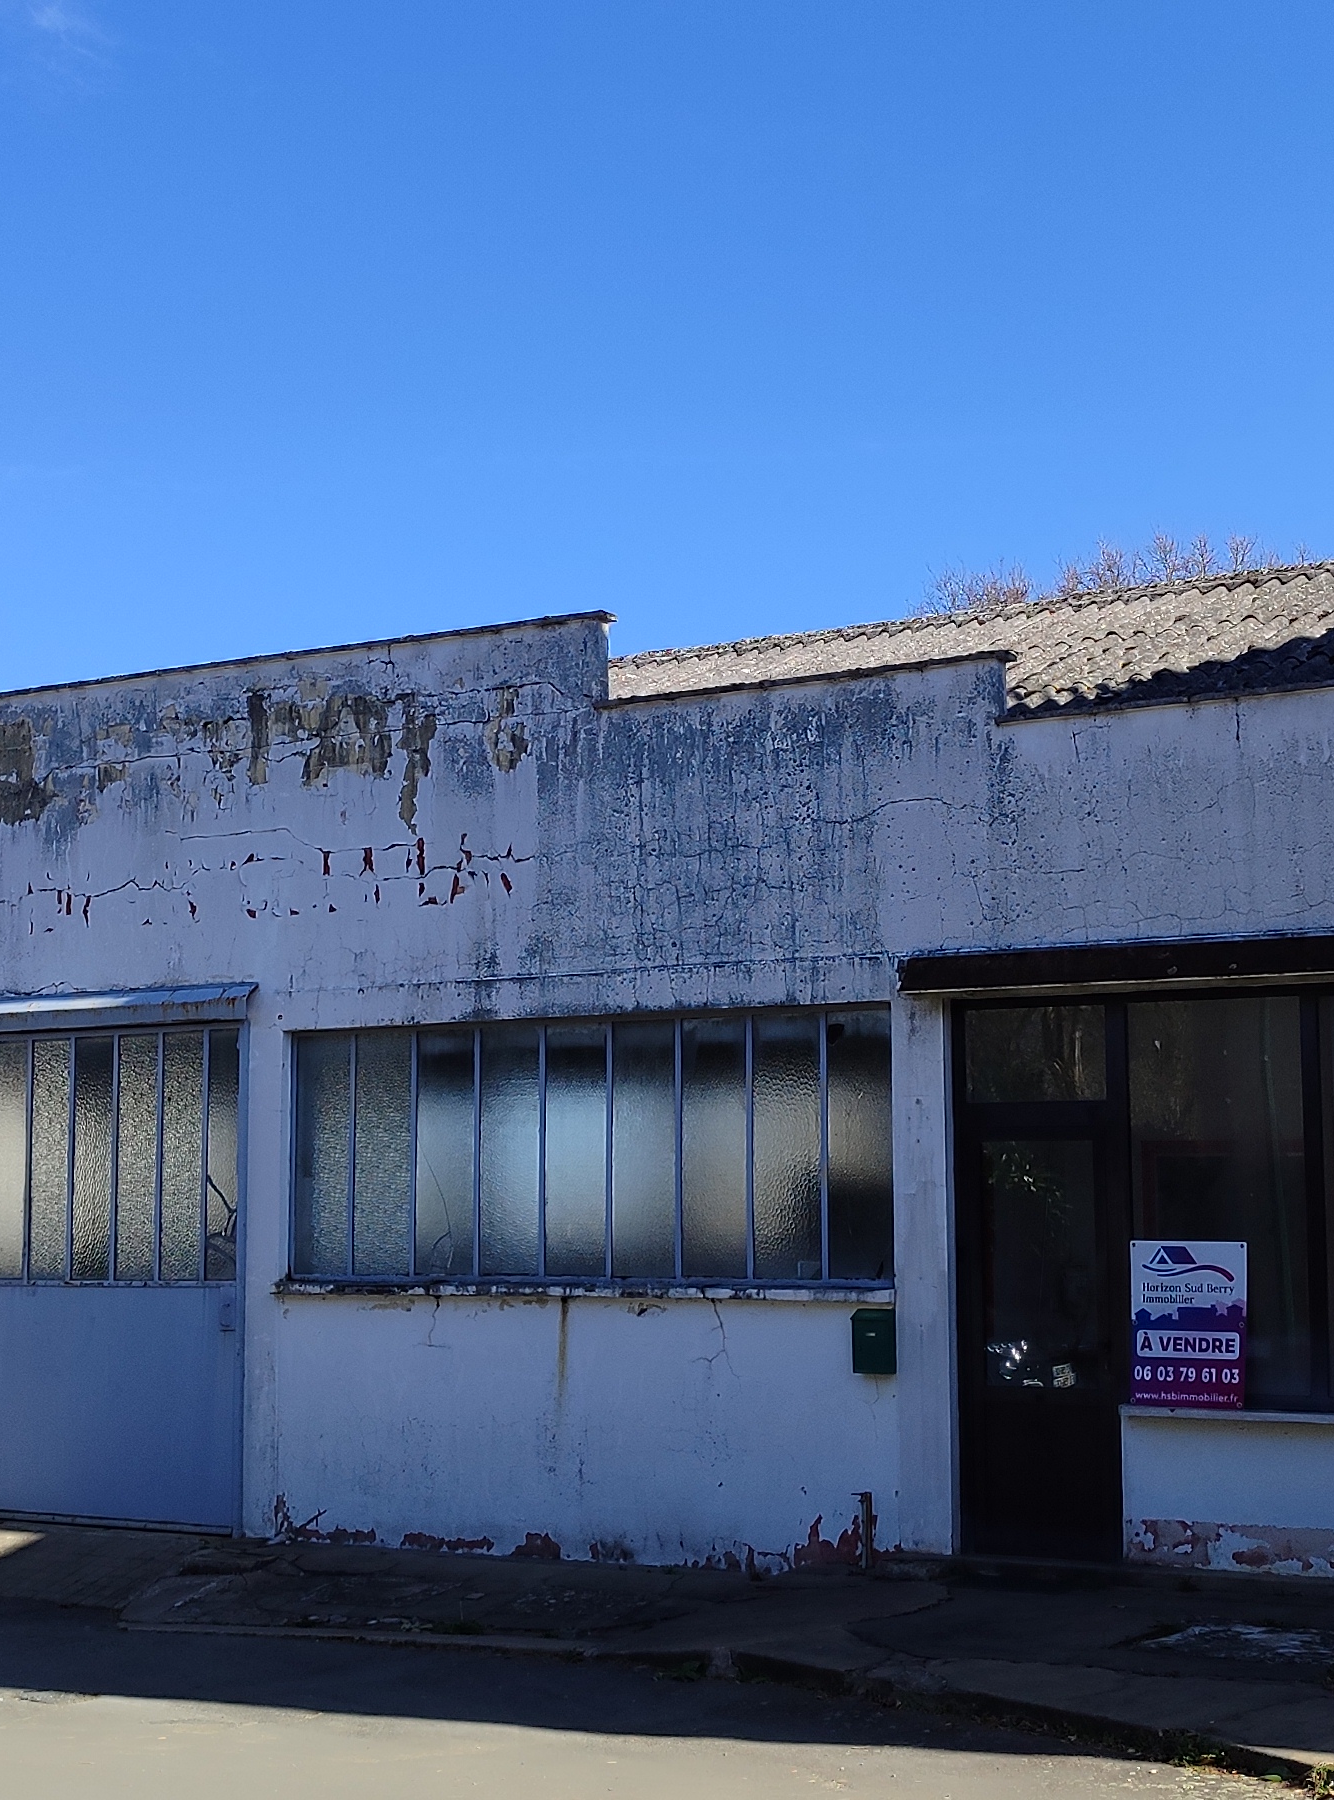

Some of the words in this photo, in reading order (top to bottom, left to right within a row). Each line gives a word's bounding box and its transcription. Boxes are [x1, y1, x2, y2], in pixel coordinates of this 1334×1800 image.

[1142, 1282, 1182, 1293] Horizon
[1184, 1282, 1204, 1293] Sud
[1207, 1283, 1235, 1296] Berry
[1142, 1293, 1195, 1304] Immobilier
[1139, 1331, 1154, 1352] À
[1158, 1335, 1236, 1354] VENDRE
[1134, 1365, 1152, 1381] 06
[1157, 1366, 1174, 1381] 03
[1179, 1366, 1196, 1382] 79
[1201, 1367, 1216, 1383] 61
[1221, 1368, 1240, 1384] 03
[1135, 1390, 1239, 1403] www.hsbimmobilier.fr
